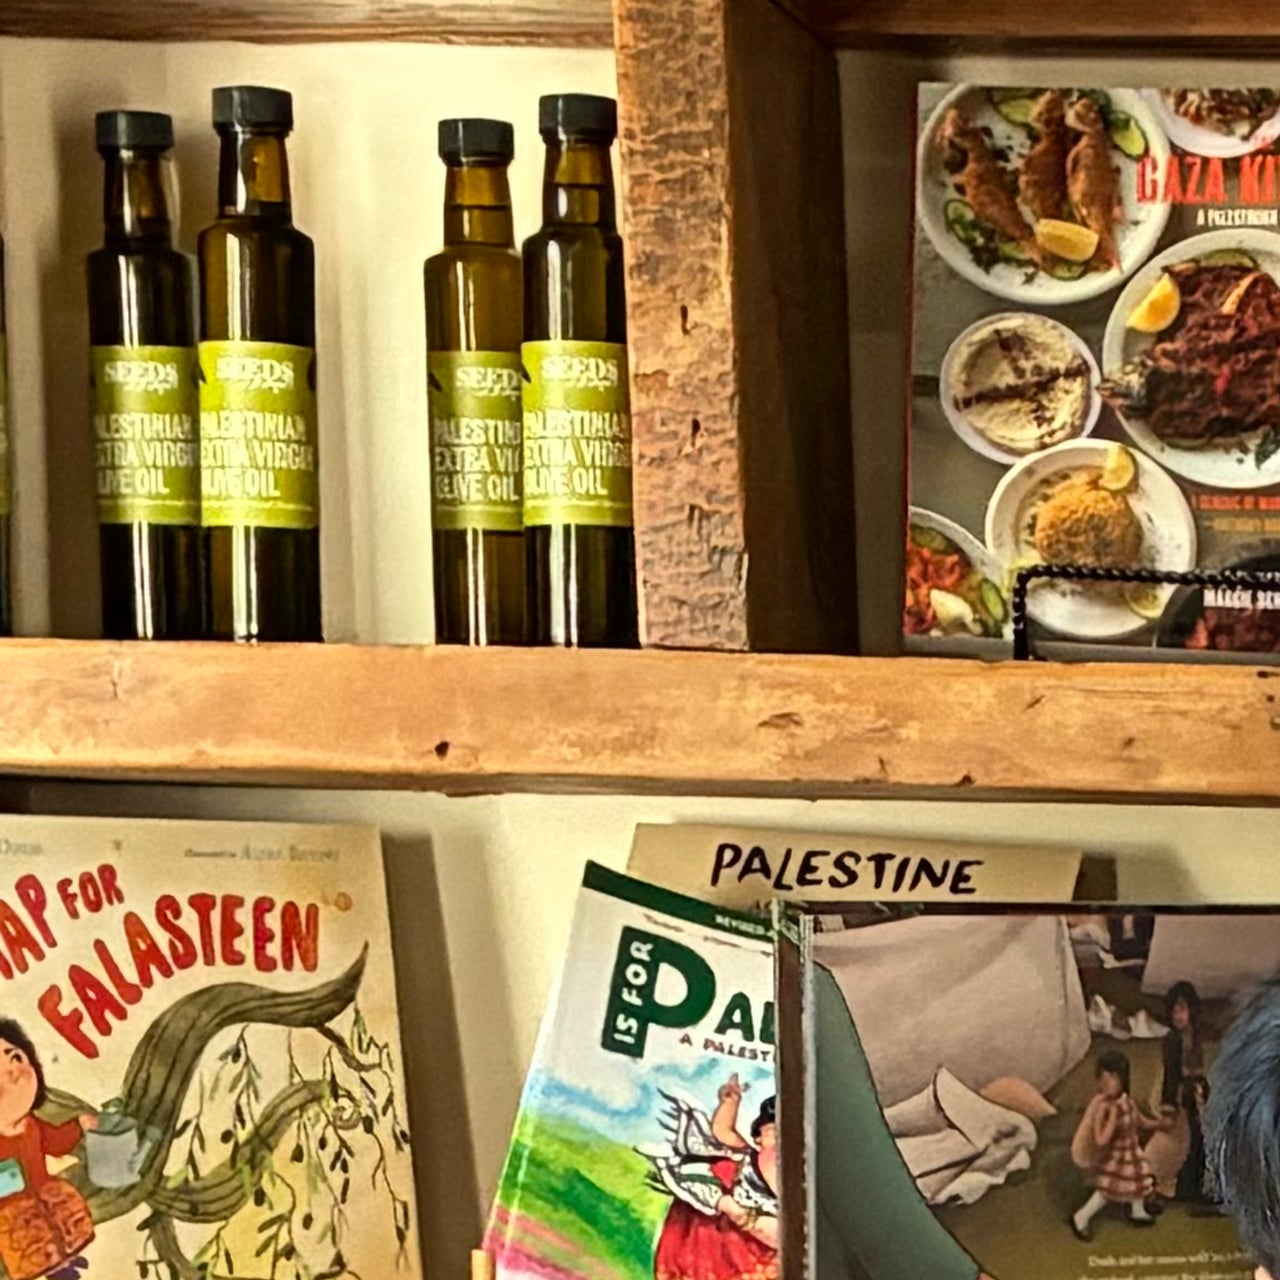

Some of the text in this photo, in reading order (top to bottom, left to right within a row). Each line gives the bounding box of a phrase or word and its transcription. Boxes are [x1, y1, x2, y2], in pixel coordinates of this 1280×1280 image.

[1136, 153, 1228, 205] GAZA
[134, 467, 170, 494] OIL
[243, 467, 281, 497] OIL
[486, 474, 520, 501] OIL
[572, 466, 608, 495] OIL
[711, 843, 984, 895] PALESTINE
[0, 863, 125, 980] AP FOR
[38, 892, 320, 1060] FALASTEEN
[621, 940, 654, 1007] FOR
[613, 1013, 639, 1045] IS
[679, 1033, 775, 1064] A PALEST
